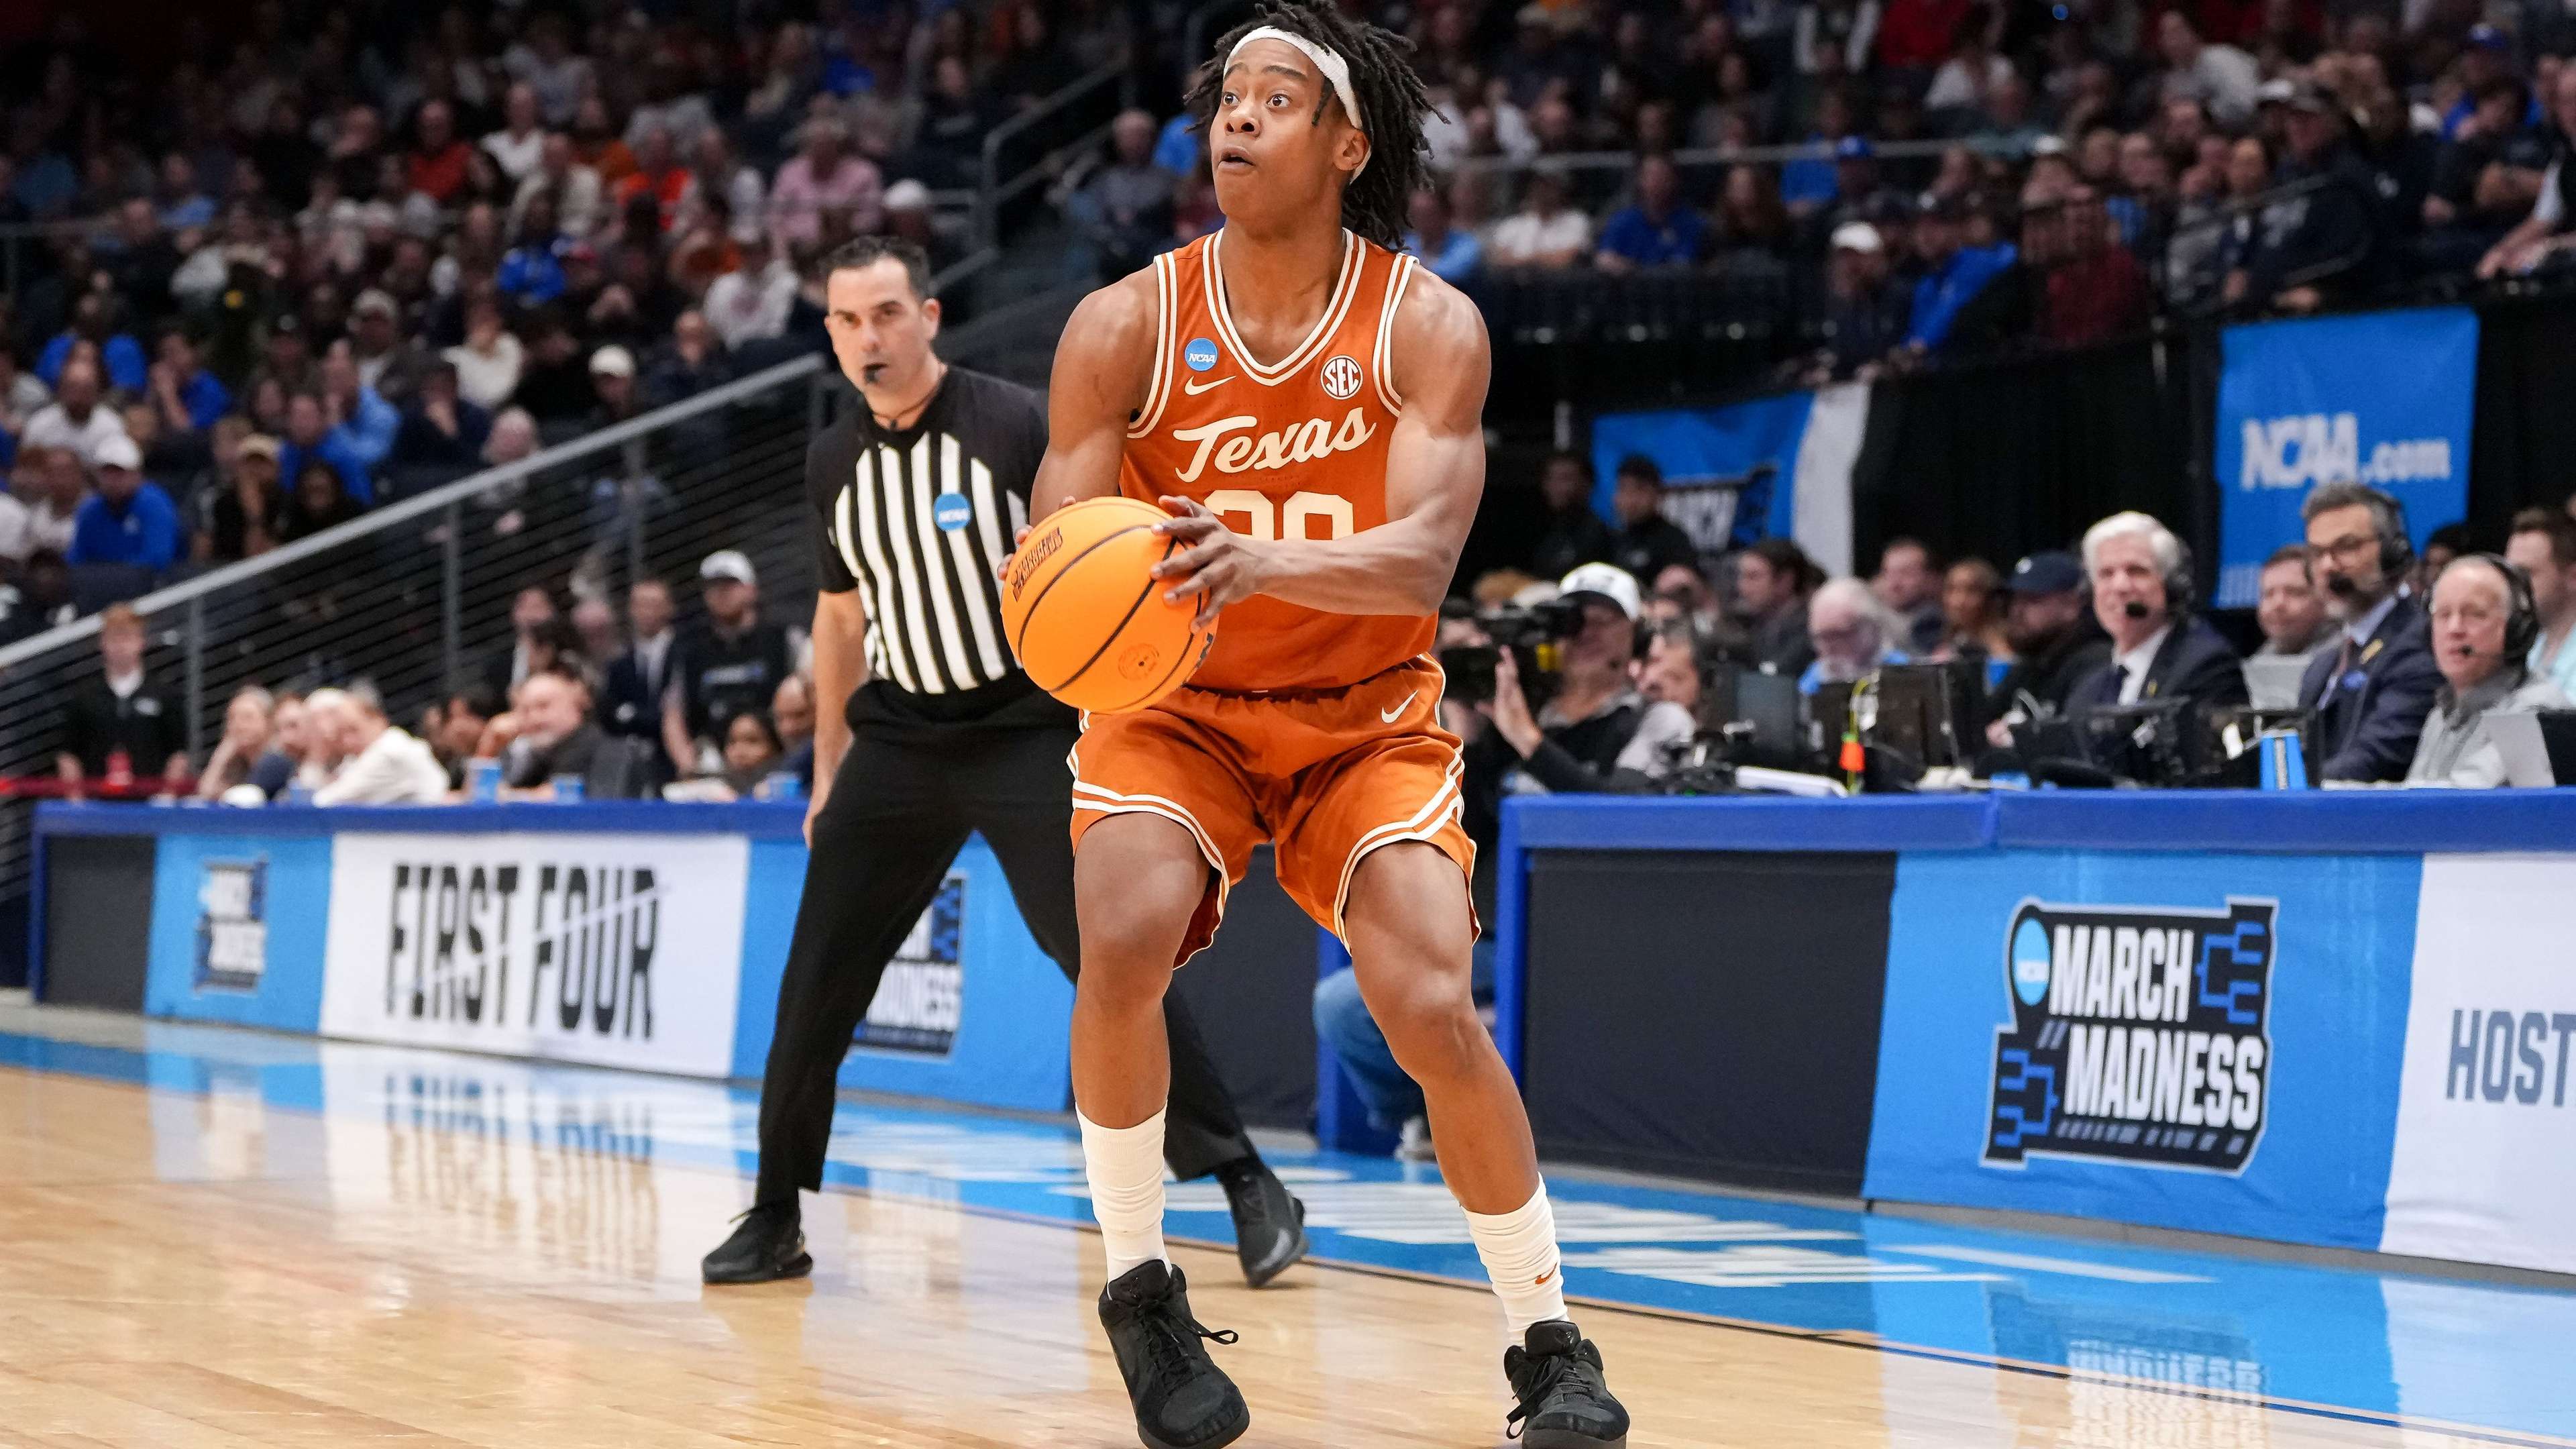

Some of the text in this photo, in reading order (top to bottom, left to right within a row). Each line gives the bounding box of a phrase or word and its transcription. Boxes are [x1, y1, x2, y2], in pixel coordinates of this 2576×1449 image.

[1188, 353, 1216, 364] NCAA
[1324, 359, 1359, 396] SEC
[1173, 407, 1377, 483] Texas
[2239, 411, 2451, 492] NCAA.com
[385, 864, 659, 1040] FIRST FOUR
[2048, 924, 2195, 1024] MARCH
[2063, 1024, 2265, 1131] MADNESS
[2447, 1009, 2576, 1108] HOST
